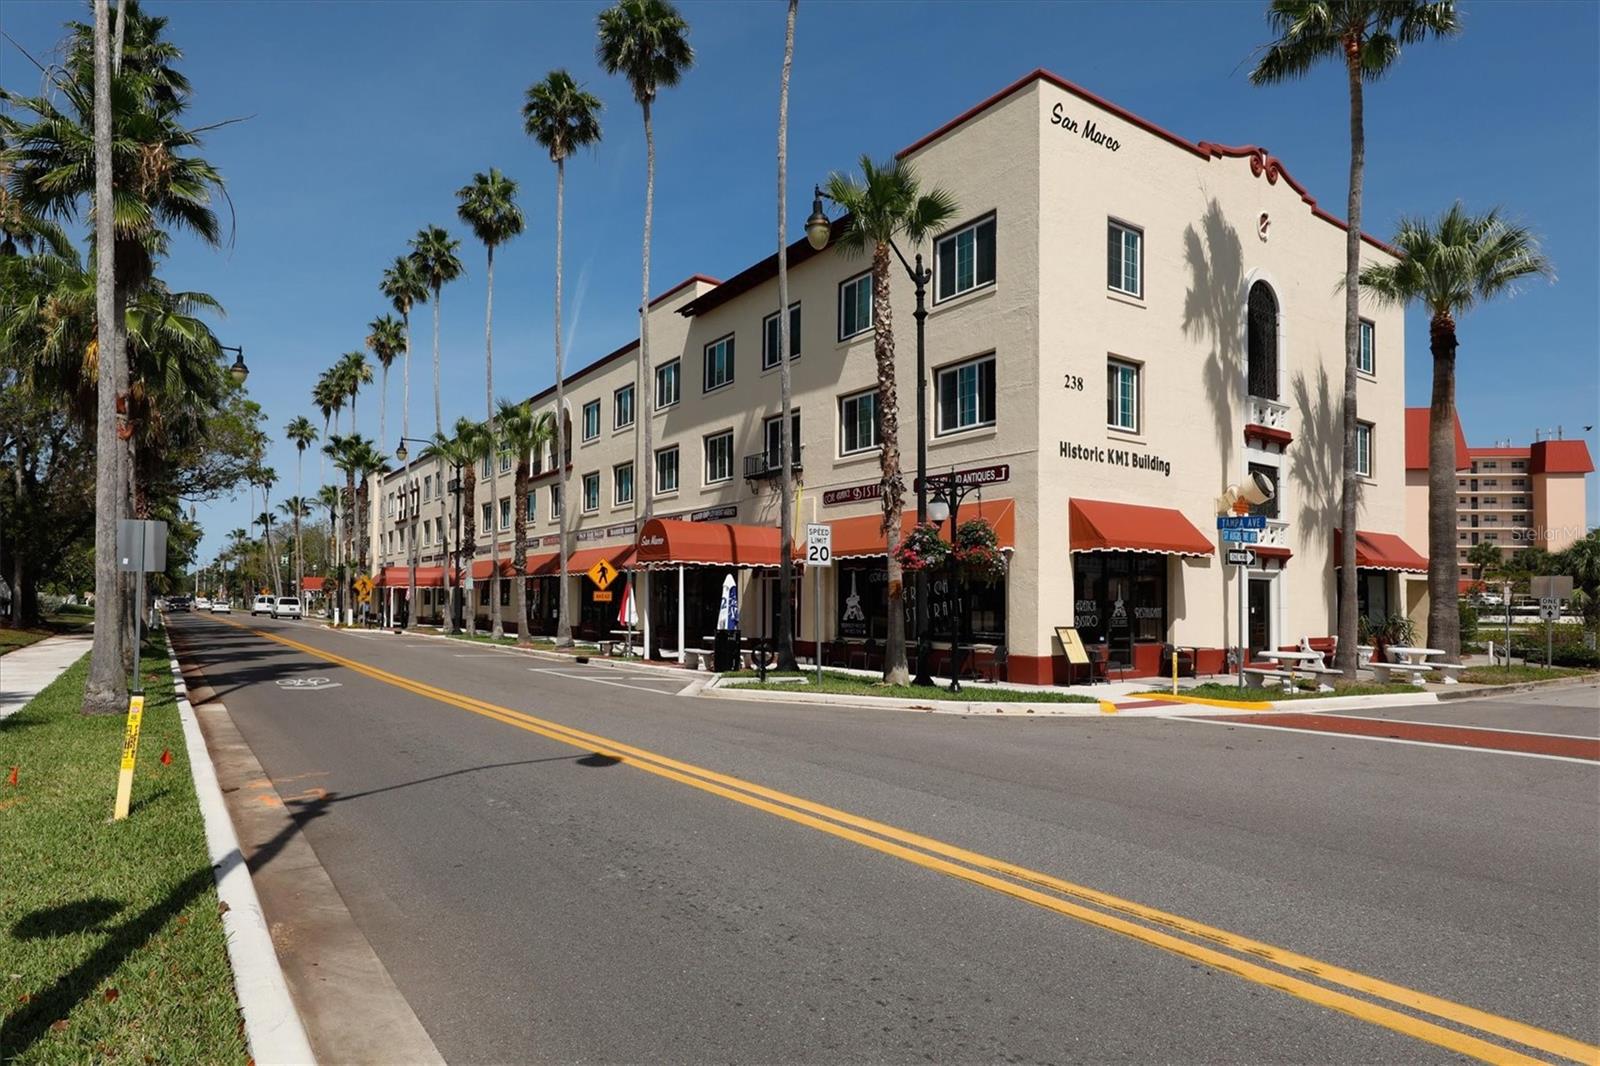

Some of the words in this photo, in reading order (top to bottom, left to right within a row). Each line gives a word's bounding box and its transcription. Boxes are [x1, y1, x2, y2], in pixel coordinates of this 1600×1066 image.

[1050, 102, 1079, 134] San
[1081, 119, 1121, 152] Marco
[1064, 374, 1084, 391] 238
[1060, 440, 1105, 463] Historic
[1107, 448, 1130, 467] KMI
[1132, 453, 1171, 477] Building
[962, 469, 996, 484] ANTIQUES
[852, 485, 881, 500] BIST
[1222, 518, 1244, 528] TAMPA
[1248, 517, 1261, 527] AVE
[809, 528, 829, 536] SPEED
[810, 546, 829, 561] 20
